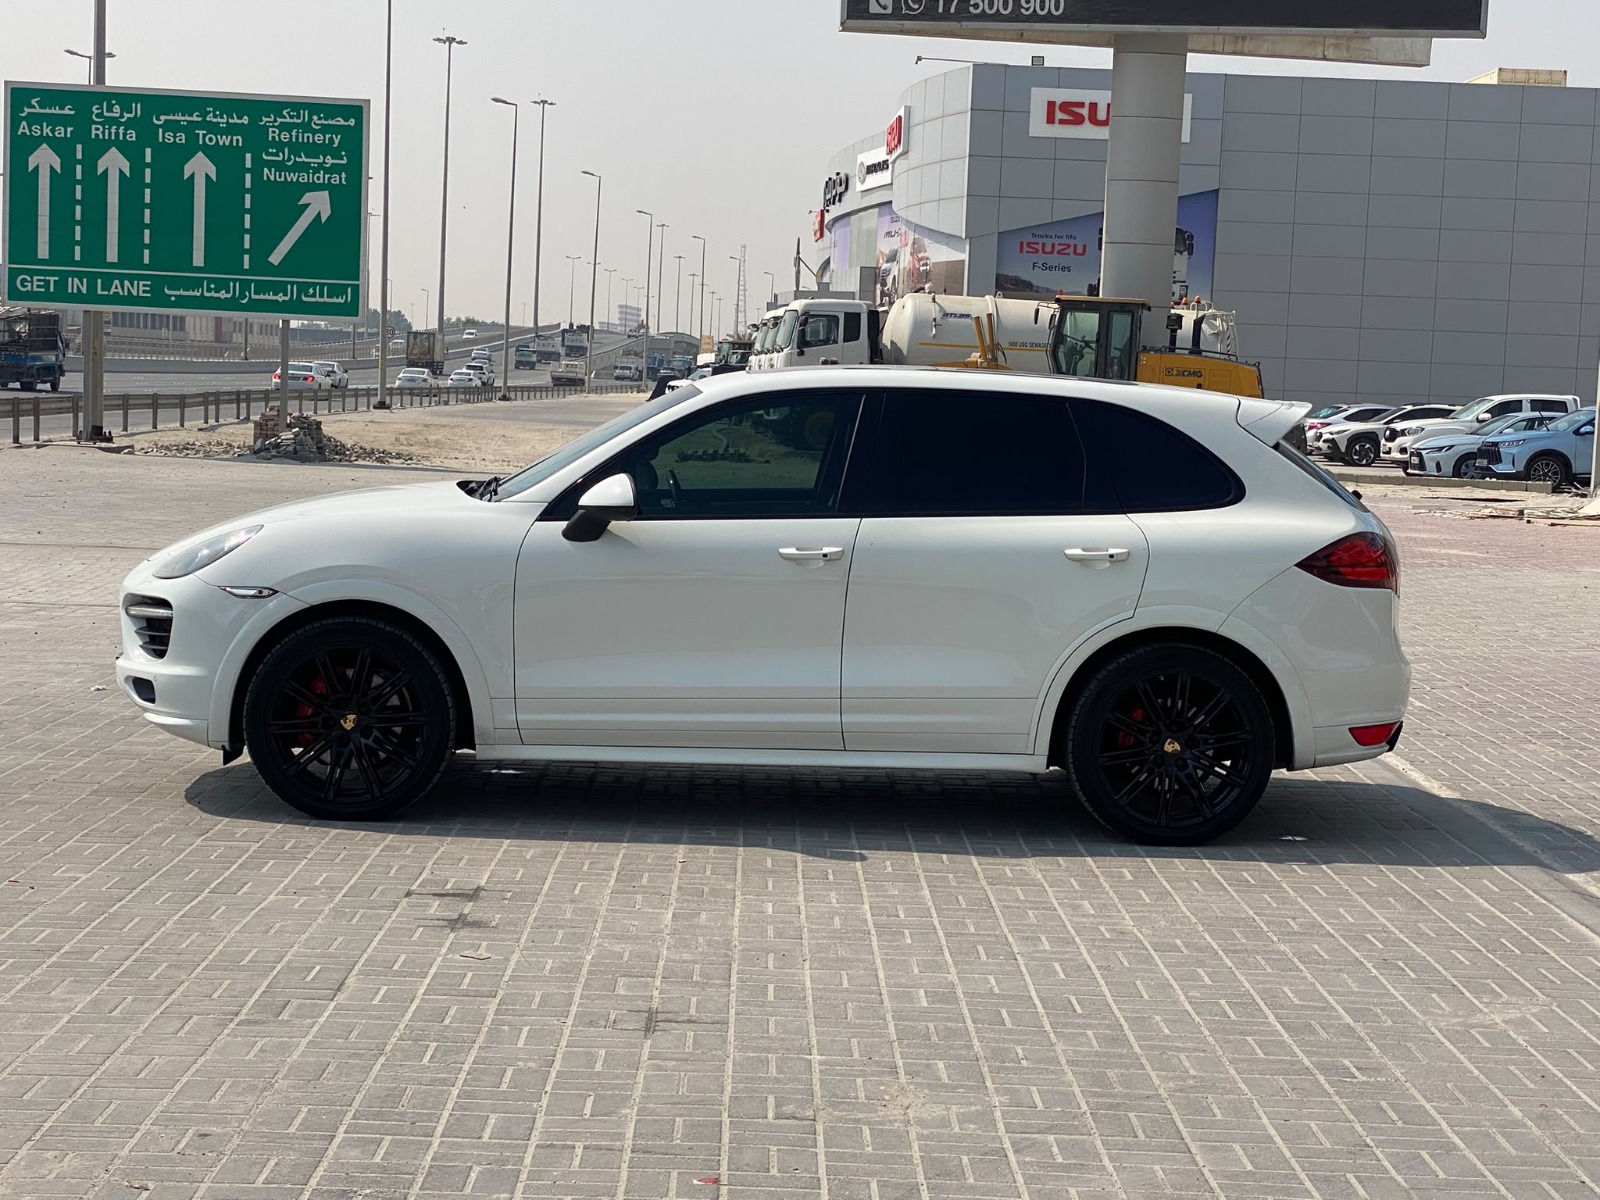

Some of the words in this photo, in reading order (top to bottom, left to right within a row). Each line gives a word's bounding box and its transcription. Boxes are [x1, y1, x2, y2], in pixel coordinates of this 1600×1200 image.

[969, 0, 1013, 15] 500
[1020, 0, 1065, 16] 900
[19, 97, 75, 116] عسكر
[92, 100, 141, 122] الرفاع
[153, 112, 202, 125] عيسى
[206, 107, 249, 127] مدينة
[258, 108, 309, 126] التكرير
[311, 113, 356, 129] مصنع
[17, 121, 74, 138] Askar
[91, 124, 137, 142] Riffa
[158, 128, 186, 144] Isa
[195, 130, 243, 147] Town
[268, 128, 341, 147] Refinery
[262, 147, 348, 167] نويدرات
[263, 167, 347, 185] Nuwaidrat
[1031, 232, 1054, 240] Trucks
[1018, 240, 1087, 257] ISUZU
[1032, 261, 1072, 273] F-Series
[16, 274, 59, 293] GET
[67, 277, 87, 294] IN
[97, 278, 152, 297] LANE
[163, 279, 239, 302] المناسب
[240, 281, 297, 304] المسار
[301, 285, 352, 304] اسلك
[1175, 369, 1203, 378] XCMG
